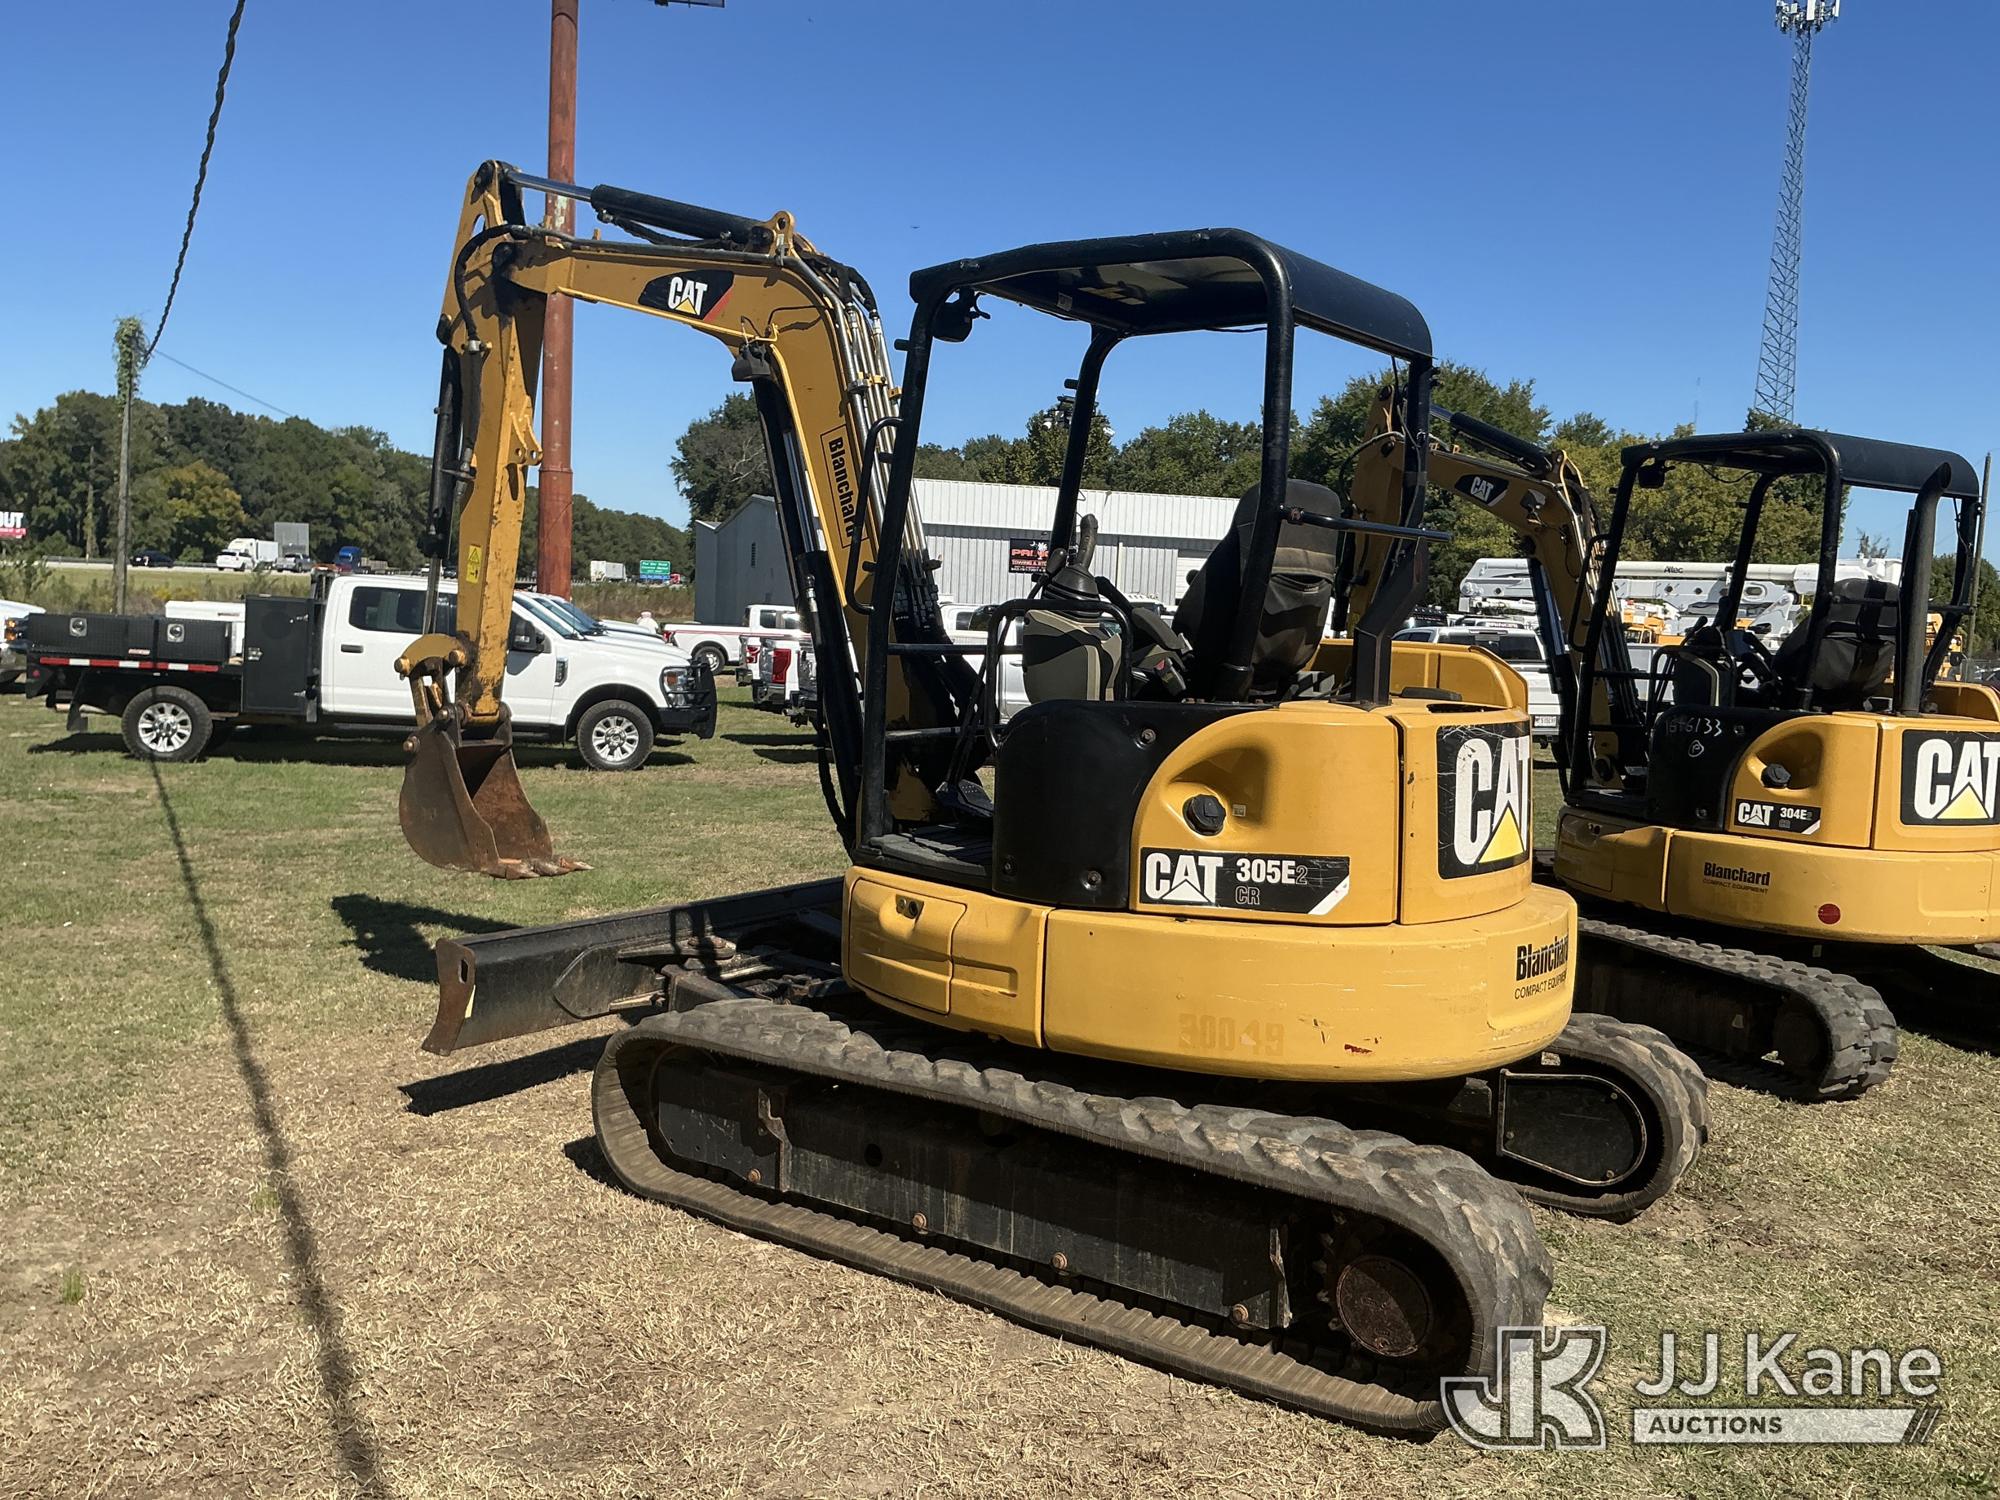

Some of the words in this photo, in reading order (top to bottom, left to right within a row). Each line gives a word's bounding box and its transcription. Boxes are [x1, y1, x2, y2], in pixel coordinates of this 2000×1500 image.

[668, 276, 708, 315] CAT
[1471, 476, 1494, 501] CAT
[1914, 738, 2000, 819] CAT
[1454, 735, 1530, 865] CAT
[1738, 802, 1774, 826] CAT
[1145, 852, 1223, 903] CAT
[1236, 857, 1308, 885] 305E2
[1703, 862, 1771, 886] Blanchard
[1235, 885, 1260, 905] CR
[1514, 980, 1547, 999] COMPACT
